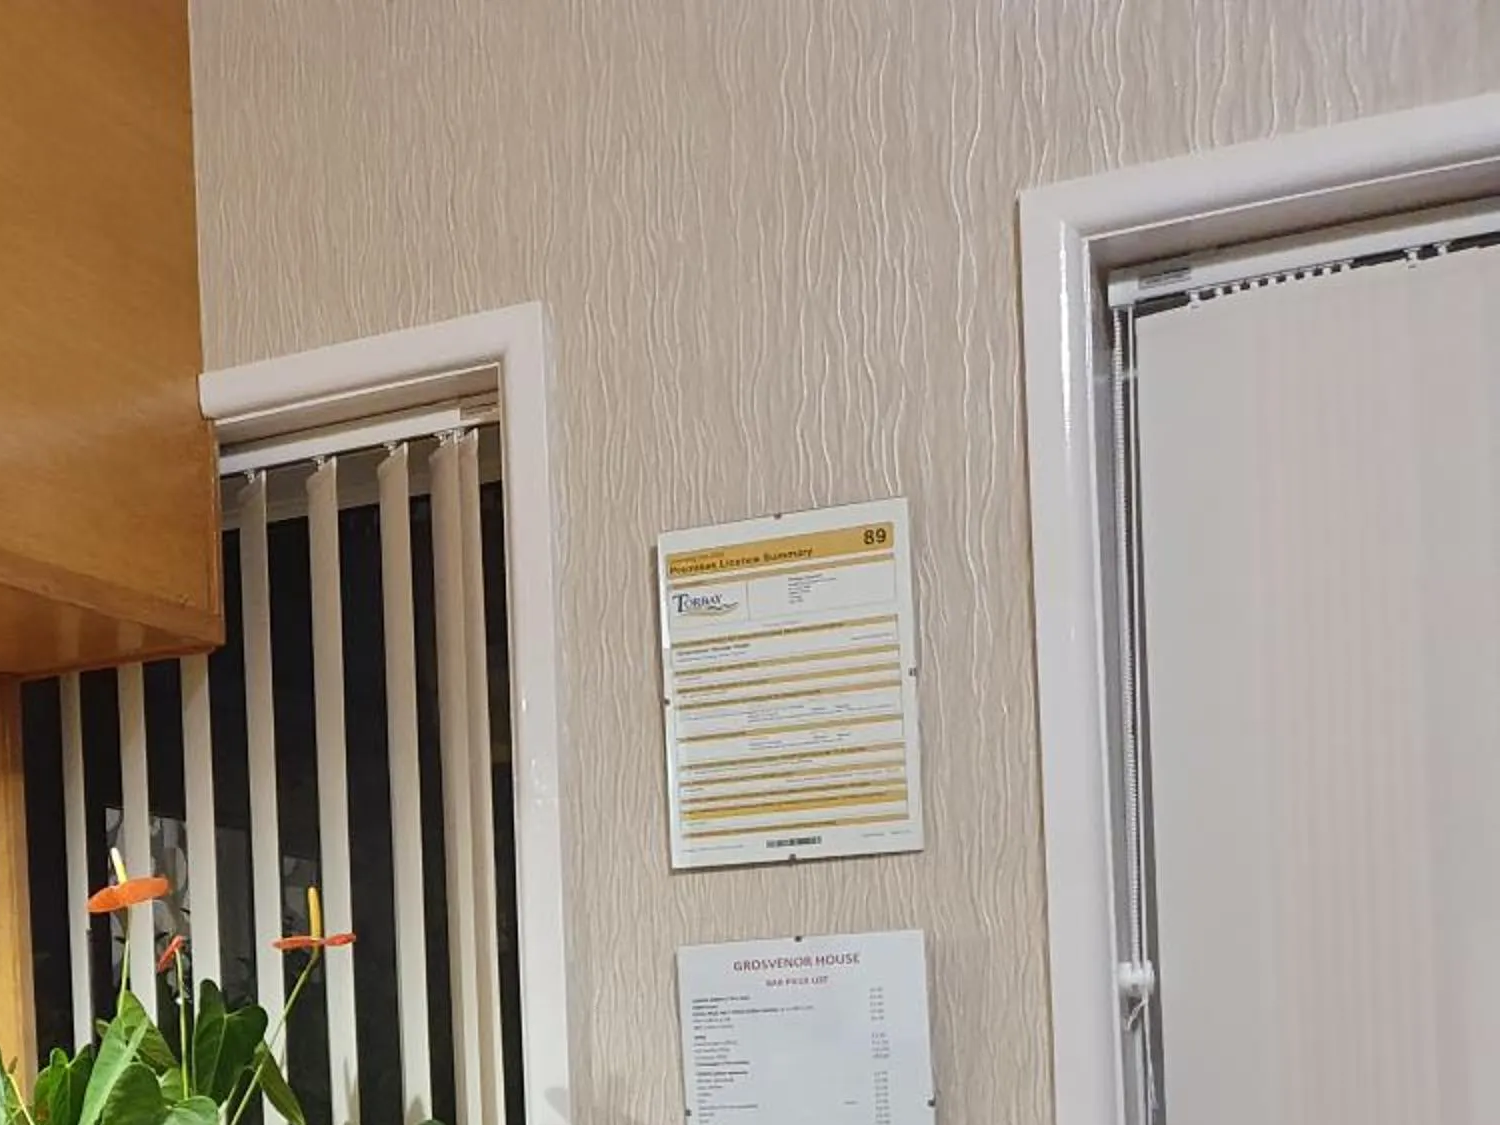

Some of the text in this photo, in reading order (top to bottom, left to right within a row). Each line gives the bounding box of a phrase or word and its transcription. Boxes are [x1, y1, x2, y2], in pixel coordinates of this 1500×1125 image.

[863, 528, 887, 546] 89
[763, 547, 813, 562] Summary
[733, 952, 861, 972] GROSVENOR HOUSE
